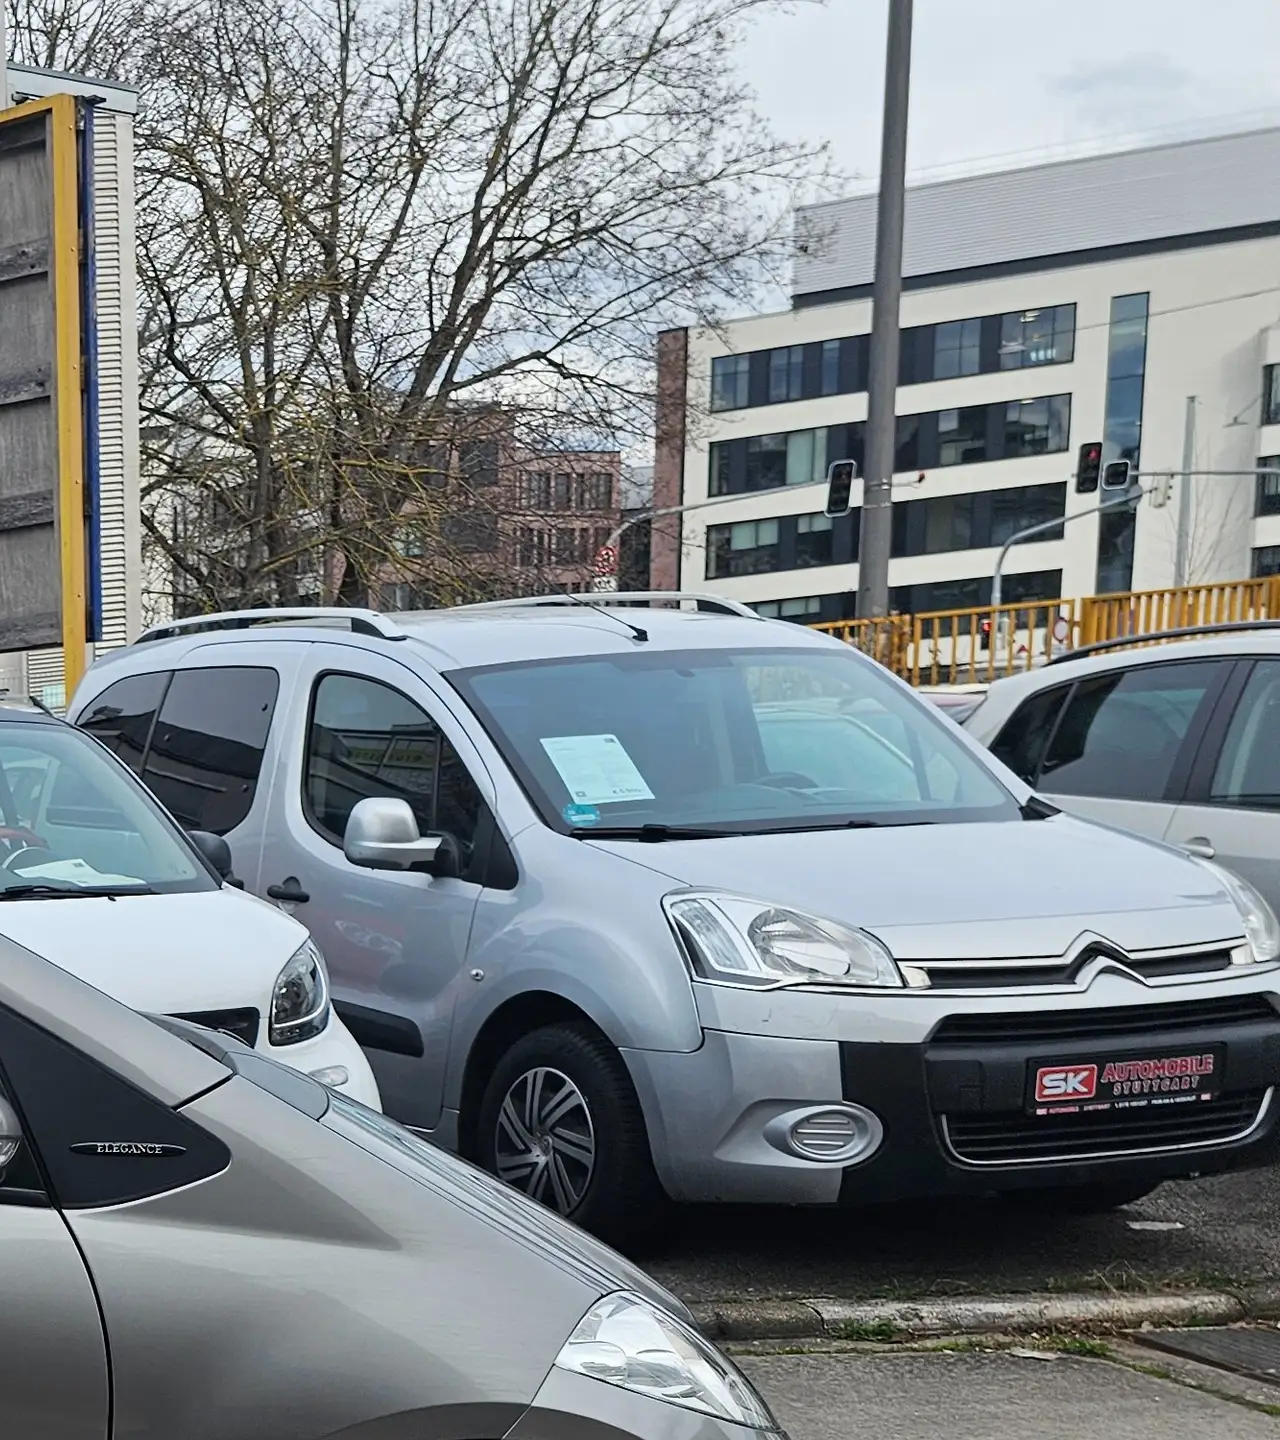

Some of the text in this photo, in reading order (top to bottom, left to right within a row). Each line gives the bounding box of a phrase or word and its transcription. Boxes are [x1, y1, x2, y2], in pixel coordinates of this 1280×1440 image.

[1042, 1054, 1214, 1095] SK AUTOMOBILE
[1112, 1076, 1201, 1096] STUTTGART
[96, 1142, 163, 1154] ELEGANCE
